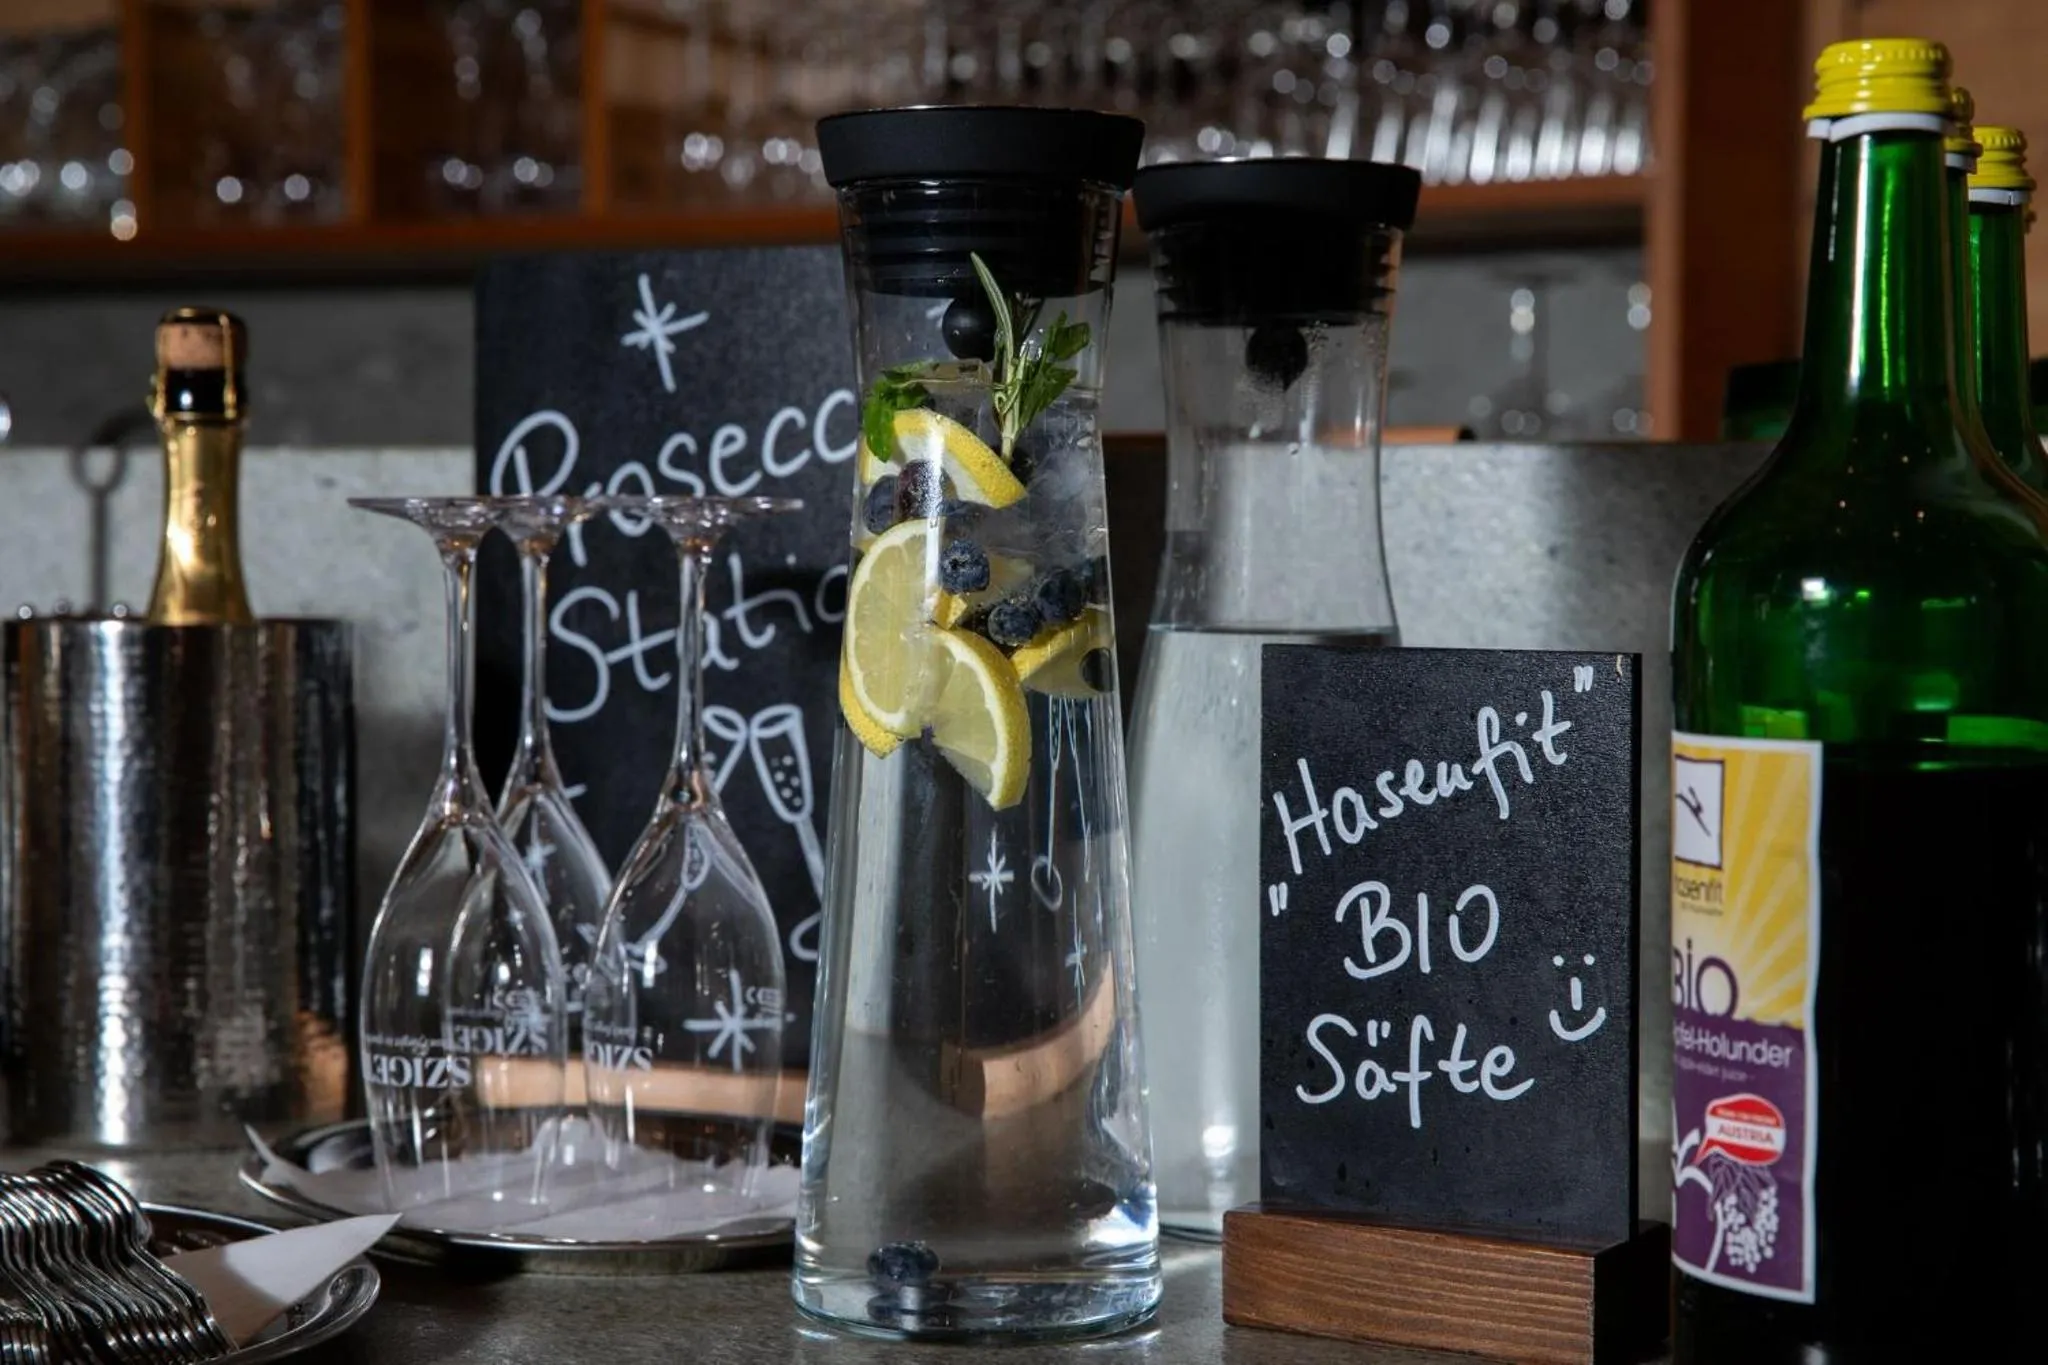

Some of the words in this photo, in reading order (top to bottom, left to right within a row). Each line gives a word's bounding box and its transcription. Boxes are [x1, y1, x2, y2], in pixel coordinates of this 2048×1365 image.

[1335, 881, 1500, 980] BIO
[1296, 1013, 1536, 1129] Säfte
[1717, 1123, 1775, 1145] AUSTRIA
